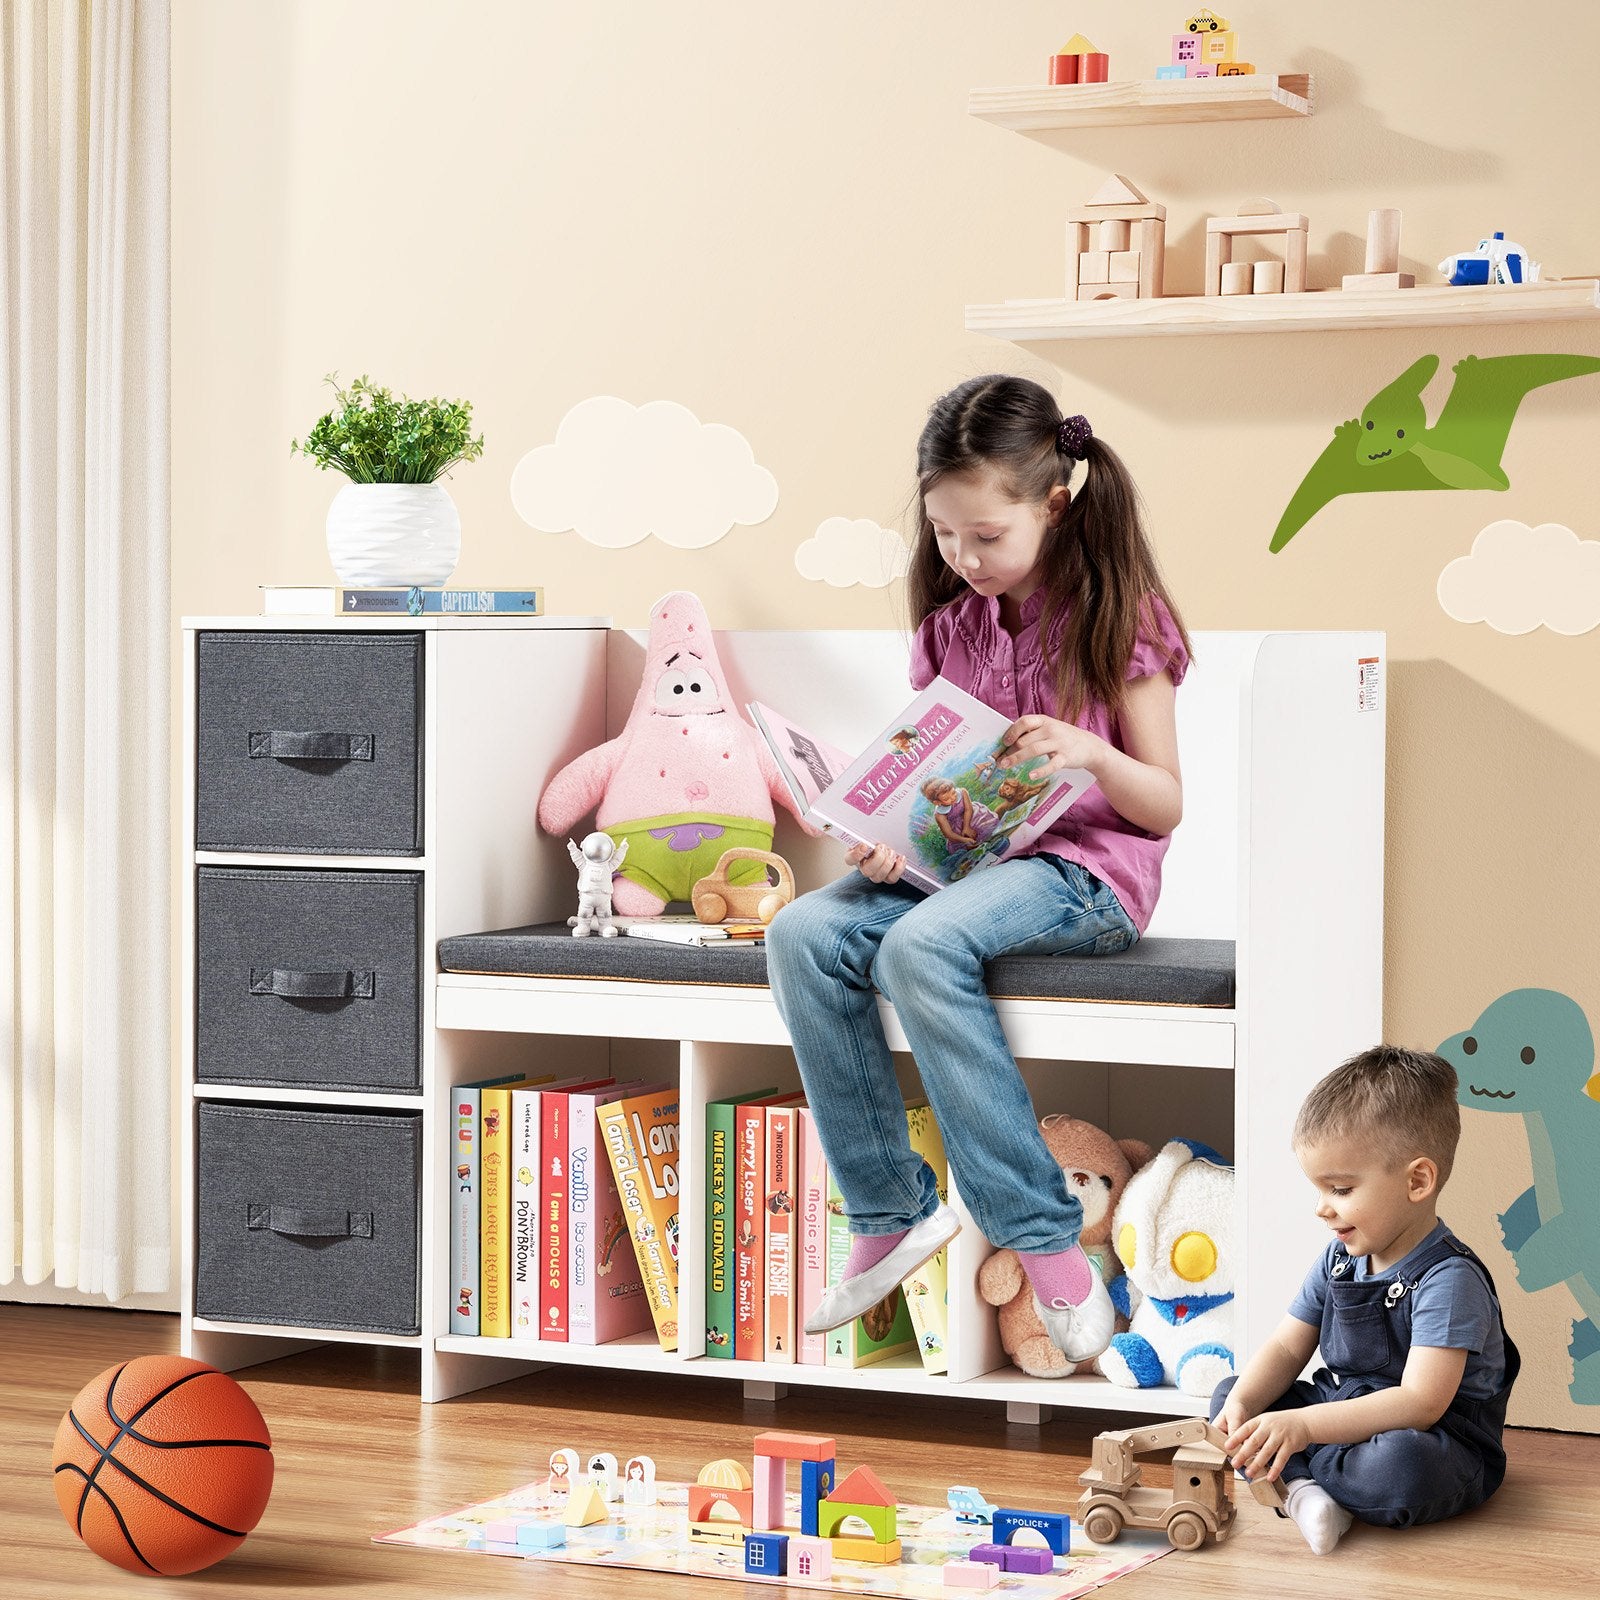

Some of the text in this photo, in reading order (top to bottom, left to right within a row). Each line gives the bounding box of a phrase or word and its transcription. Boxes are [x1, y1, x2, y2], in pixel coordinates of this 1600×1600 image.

[357, 598, 399, 606] INTRODUCING
[441, 591, 495, 613] CAPITALISM
[855, 714, 951, 807] Martynka
[875, 784, 910, 818] Wielka
[458, 1104, 474, 1156] BLUE
[606, 1124, 627, 1155] am
[618, 1167, 644, 1218] Loser
[742, 1118, 760, 1216] Barry Loser
[774, 1131, 784, 1183] INTRODUCING
[550, 1200, 560, 1223] am
[550, 1224, 560, 1234] a
[572, 1146, 589, 1286] Vanilla ice cream
[712, 1130, 726, 1293] MICKEY & DONALD
[804, 1188, 821, 1270] Magic girl
[516, 1200, 530, 1282] PONYBROWN
[549, 1235, 561, 1290] mouse
[646, 1240, 666, 1278] Barry
[739, 1251, 752, 1277] Jim
[769, 1232, 789, 1298] NIETZSCHE
[655, 1277, 673, 1309] Loser
[739, 1279, 752, 1322] Smith
[1012, 1518, 1043, 1528] POLICE
